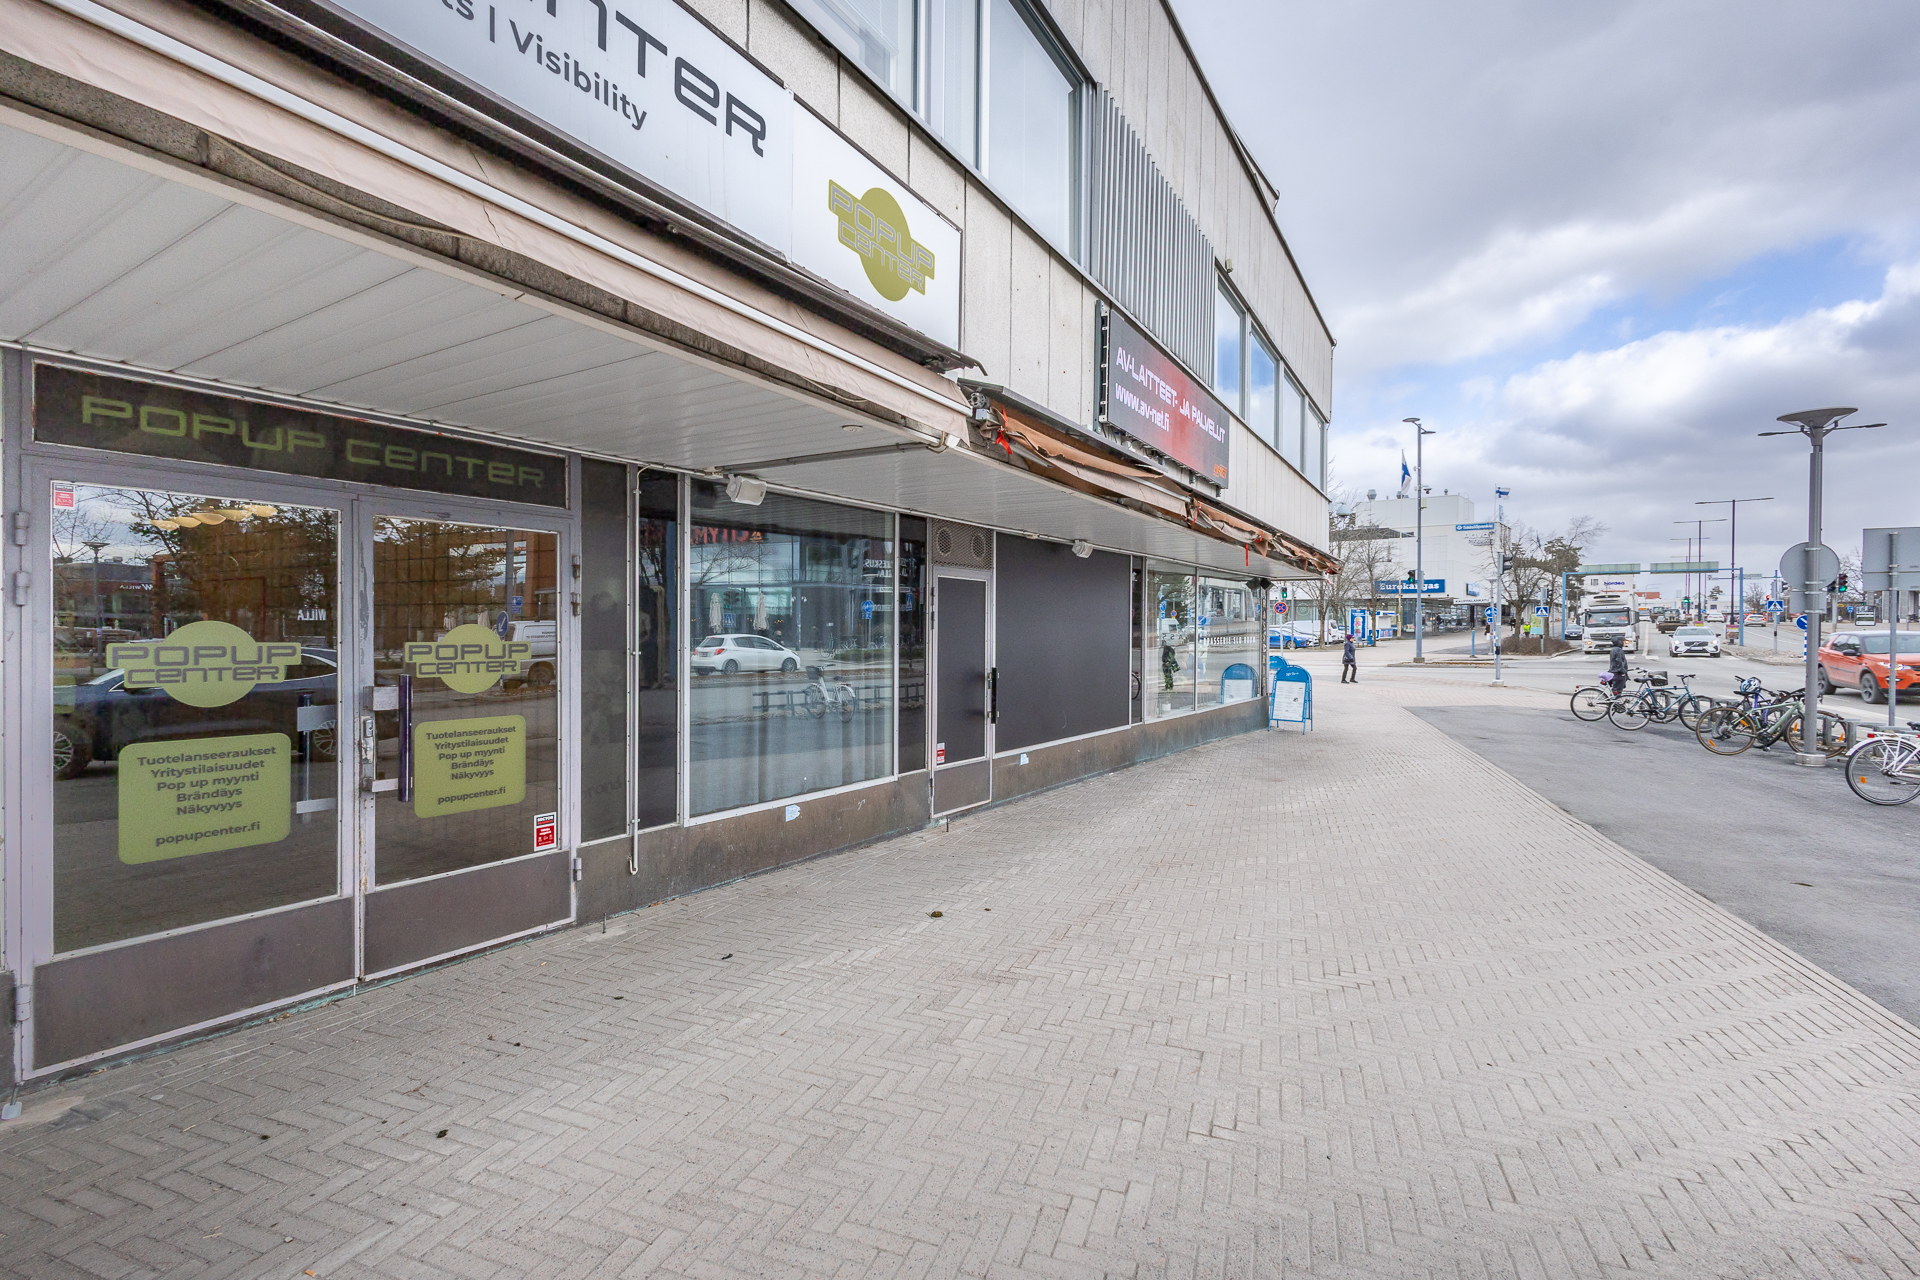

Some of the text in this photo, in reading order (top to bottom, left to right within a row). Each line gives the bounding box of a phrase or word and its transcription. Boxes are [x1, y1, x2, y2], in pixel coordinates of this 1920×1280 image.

[509, 18, 648, 130] Visibility
[831, 184, 933, 270] POPUP
[1115, 382, 1170, 432] www.av-net.fi
[81, 394, 326, 454] POPUP
[1179, 398, 1191, 419] JA
[1192, 405, 1226, 444] PALVELUT
[111, 645, 297, 668] POPUP
[408, 643, 529, 661] POPUP
[426, 726, 516, 740] Tuotelanseeraukset
[434, 736, 509, 750] Yritystilaisuudet
[459, 751, 472, 759] up
[474, 746, 506, 757] myynti
[137, 746, 277, 766] Tuotelanseeraukset
[451, 759, 494, 770] Brändäys
[150, 759, 265, 778] Yritystilaisuudet
[451, 769, 494, 780] Näkyvyys
[157, 771, 259, 791] Pop up myynti
[176, 788, 243, 802] Brändäys
[437, 786, 506, 805] popupcenter.fi
[176, 800, 243, 815] Näkyvyys
[155, 821, 261, 847] popupcenter.fi
